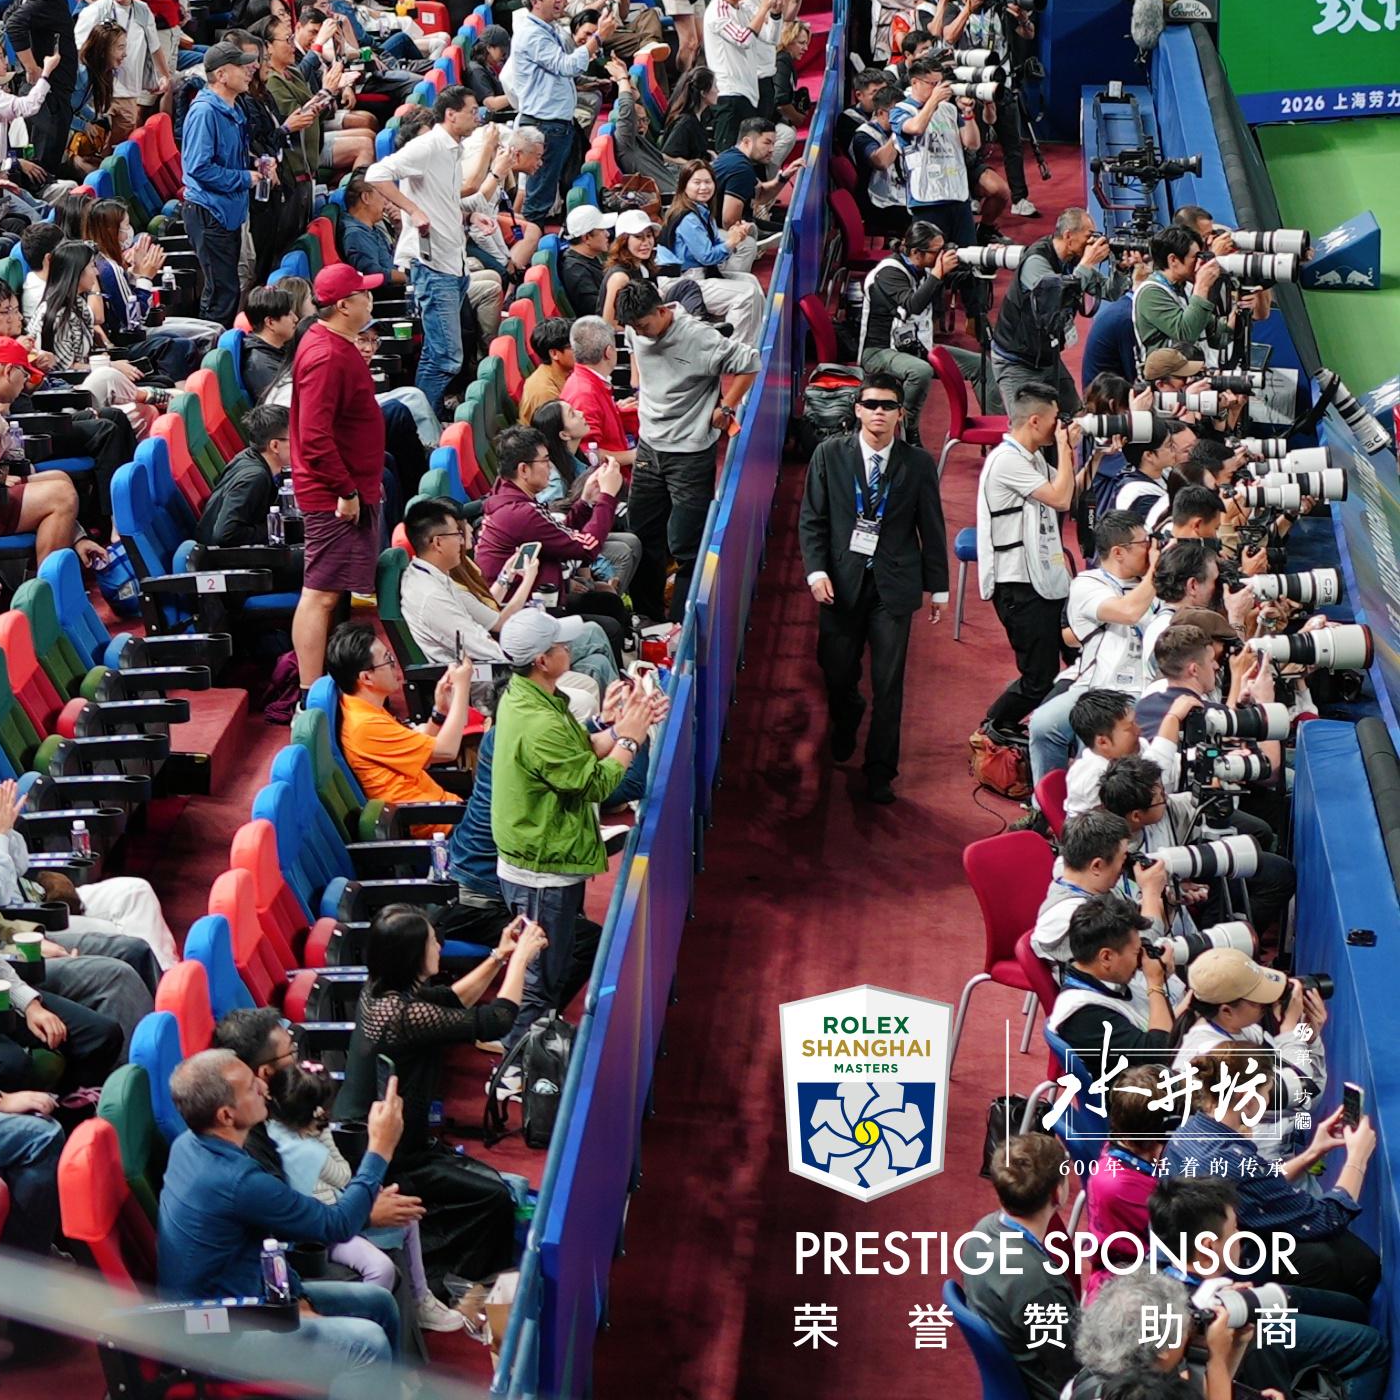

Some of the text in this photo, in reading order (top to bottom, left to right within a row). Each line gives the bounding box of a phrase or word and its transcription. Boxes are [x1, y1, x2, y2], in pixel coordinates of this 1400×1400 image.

[1281, 90, 1400, 113] 2026 上海劳力
[206, 578, 216, 590] 2
[202, 1313, 211, 1330] 1
